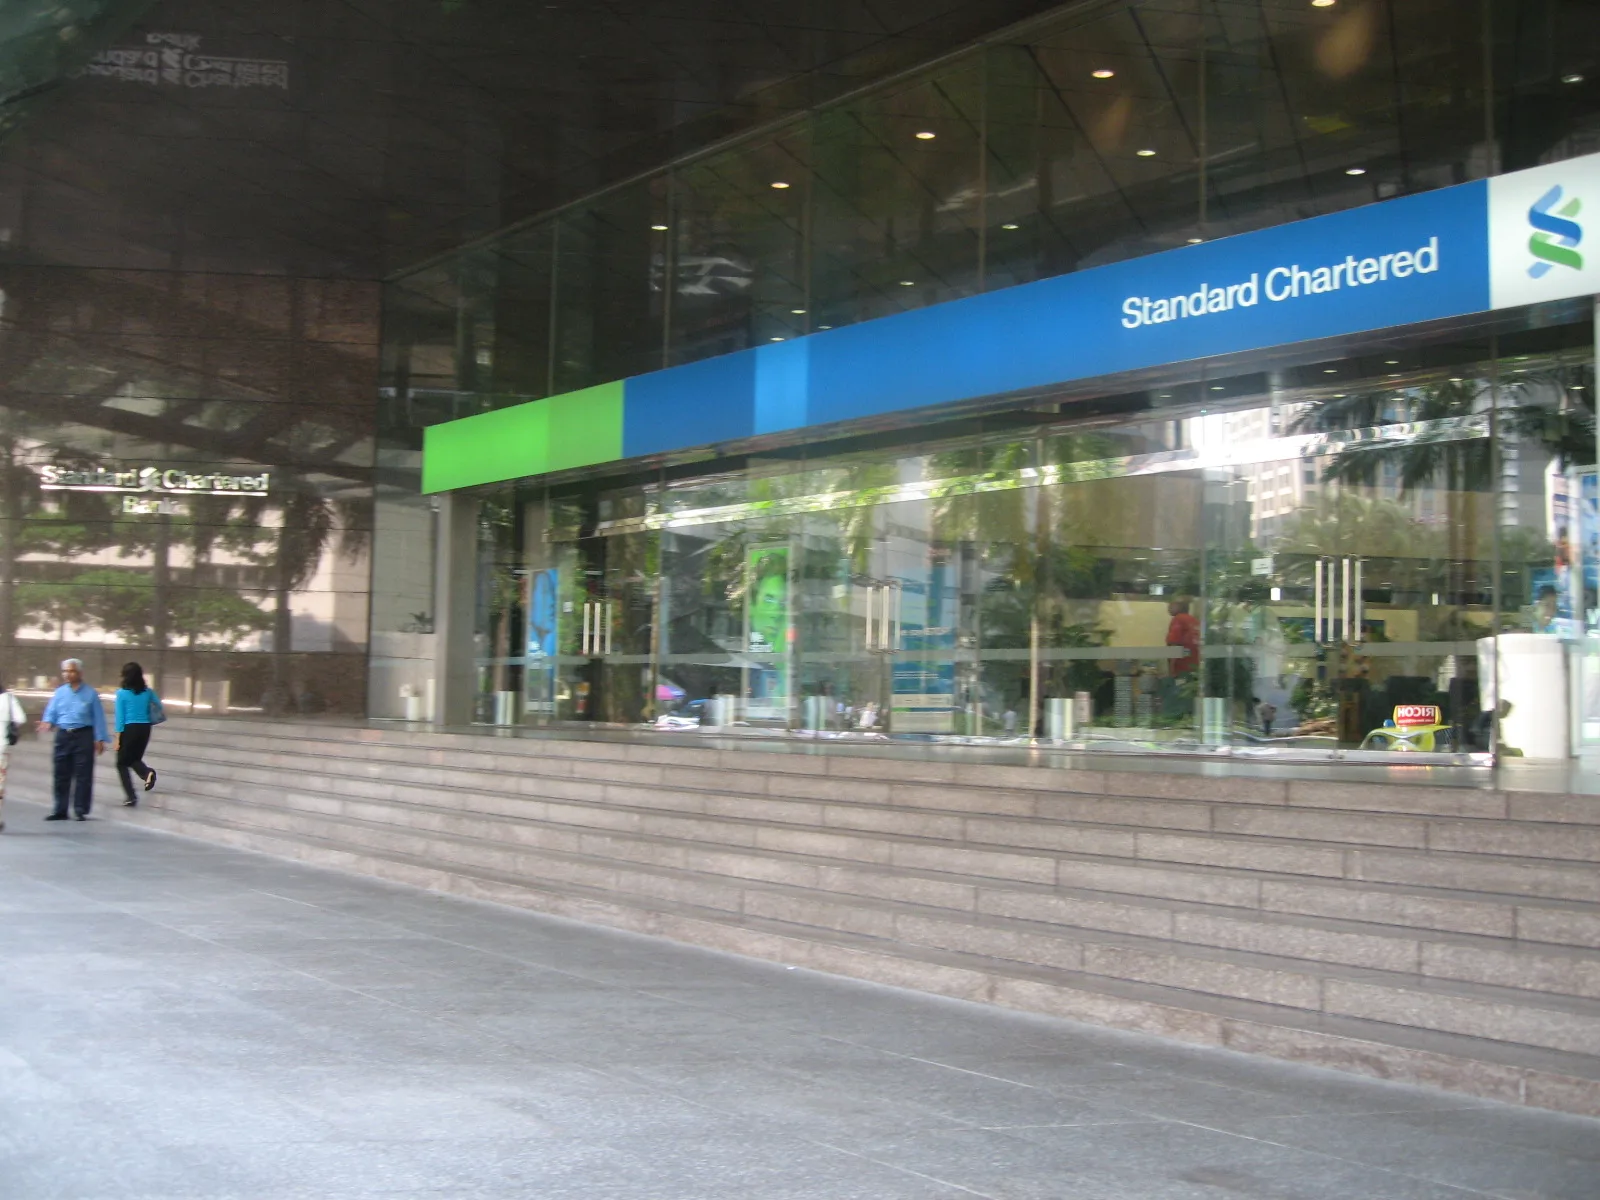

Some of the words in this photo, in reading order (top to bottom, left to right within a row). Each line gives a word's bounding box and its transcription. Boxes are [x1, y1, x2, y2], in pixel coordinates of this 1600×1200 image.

[1121, 273, 1259, 329] Standard
[1265, 236, 1439, 302] Chartered
[40, 465, 138, 486] Standard
[162, 469, 270, 491] Chartered
[122, 495, 179, 514] Bank
